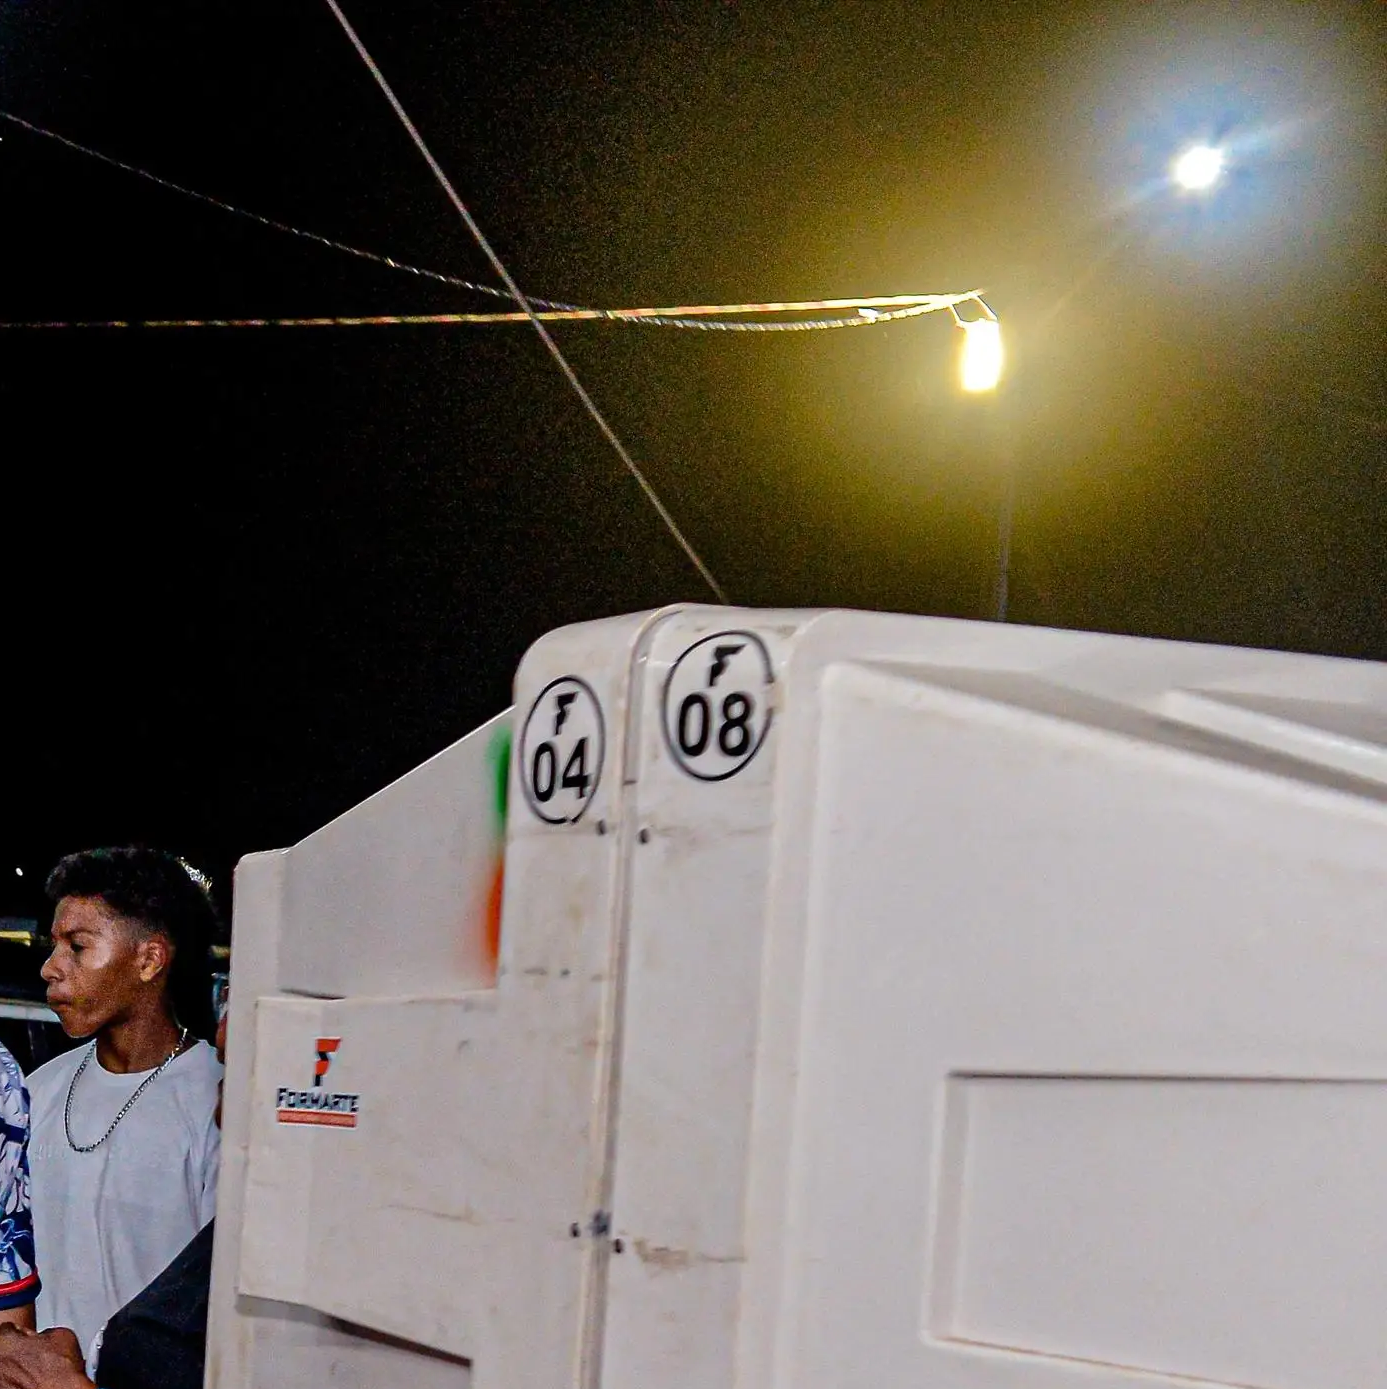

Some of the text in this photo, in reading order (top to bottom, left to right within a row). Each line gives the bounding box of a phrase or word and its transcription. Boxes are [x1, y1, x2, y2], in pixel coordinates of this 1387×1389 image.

[677, 692, 754, 757] 08
[532, 736, 591, 804] 04
[276, 1087, 360, 1113] FORMARTE
